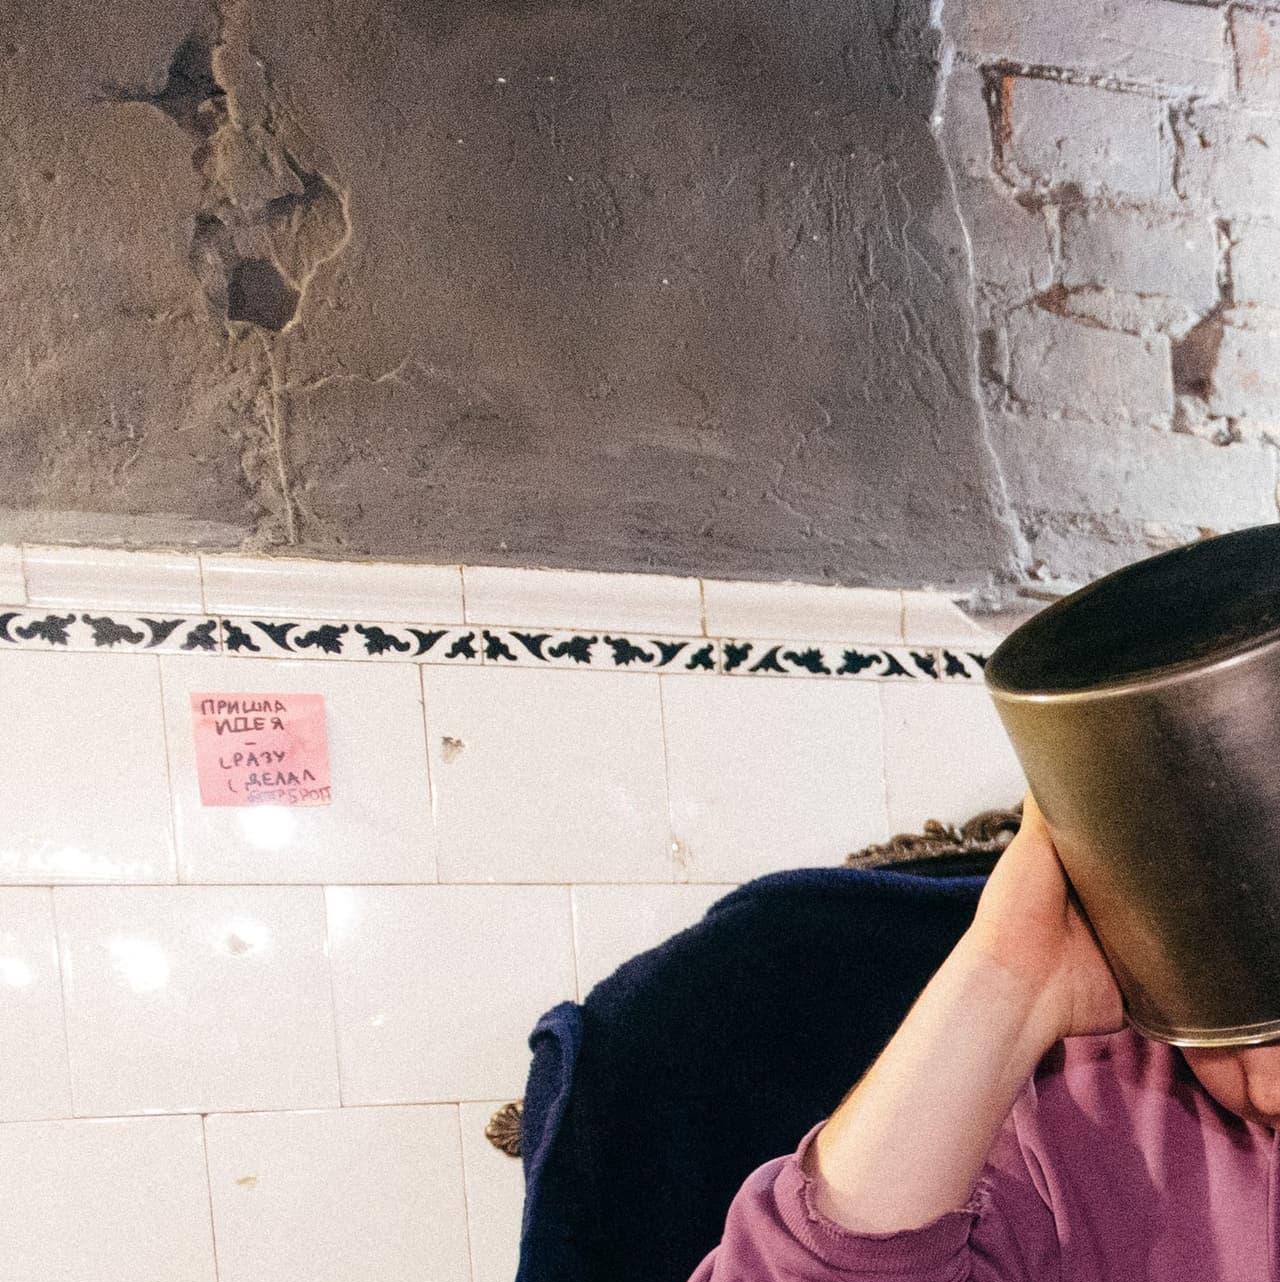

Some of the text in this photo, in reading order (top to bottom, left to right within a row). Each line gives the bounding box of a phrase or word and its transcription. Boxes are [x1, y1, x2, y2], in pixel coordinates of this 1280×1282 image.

[201, 699, 287, 715] ПРИШЛА
[216, 717, 284, 735] ИДЕЯ
[219, 751, 286, 769] СРАЗУ
